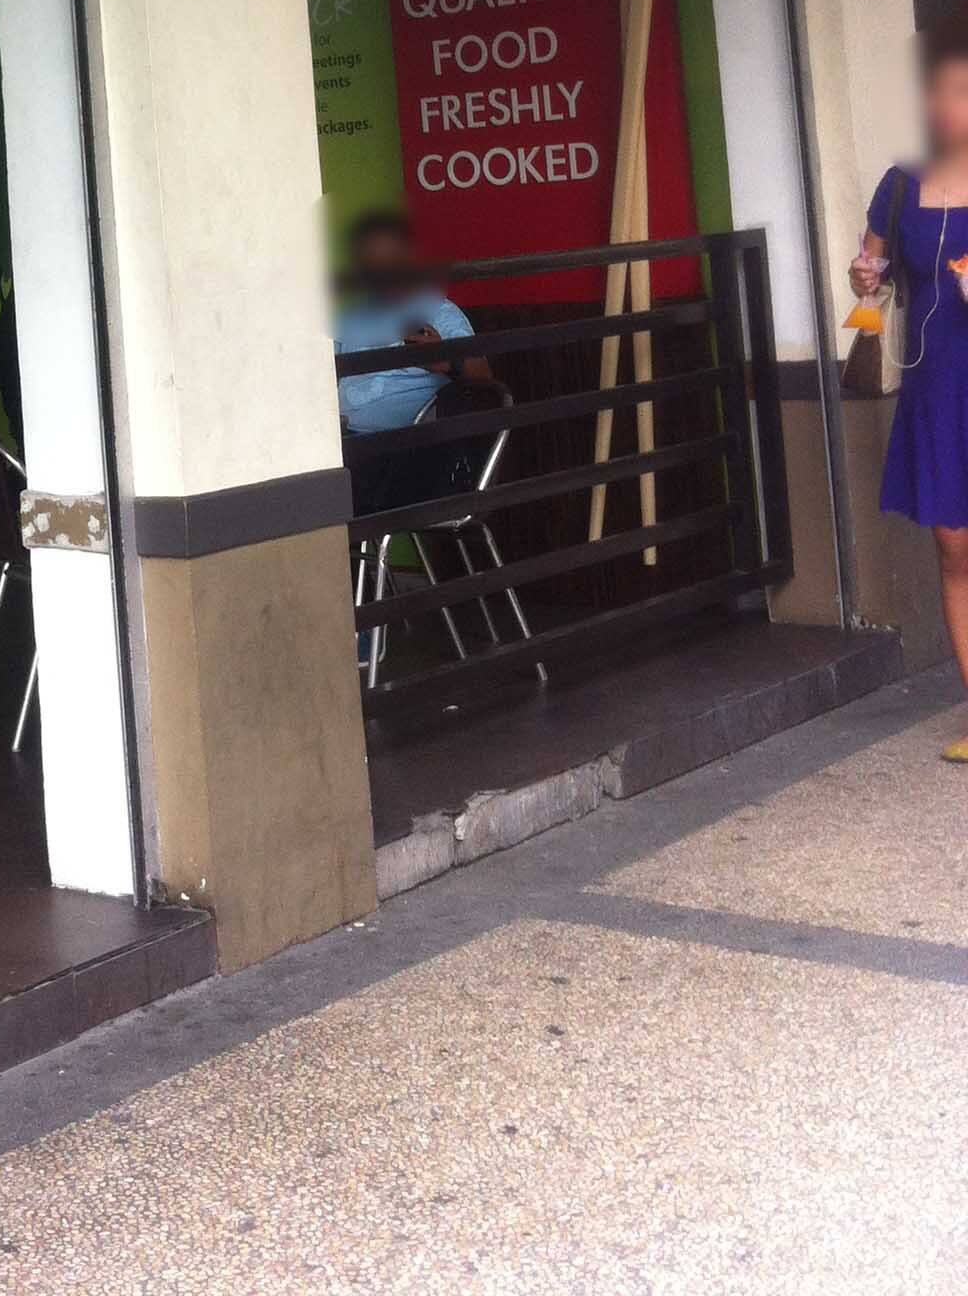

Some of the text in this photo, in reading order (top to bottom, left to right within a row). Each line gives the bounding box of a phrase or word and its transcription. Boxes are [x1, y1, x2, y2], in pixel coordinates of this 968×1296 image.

[313, 52, 363, 70] eetings
[432, 26, 559, 77] FOOD
[314, 76, 352, 91] vents
[419, 80, 585, 134] FRESHLY
[415, 141, 600, 192] COOKED
